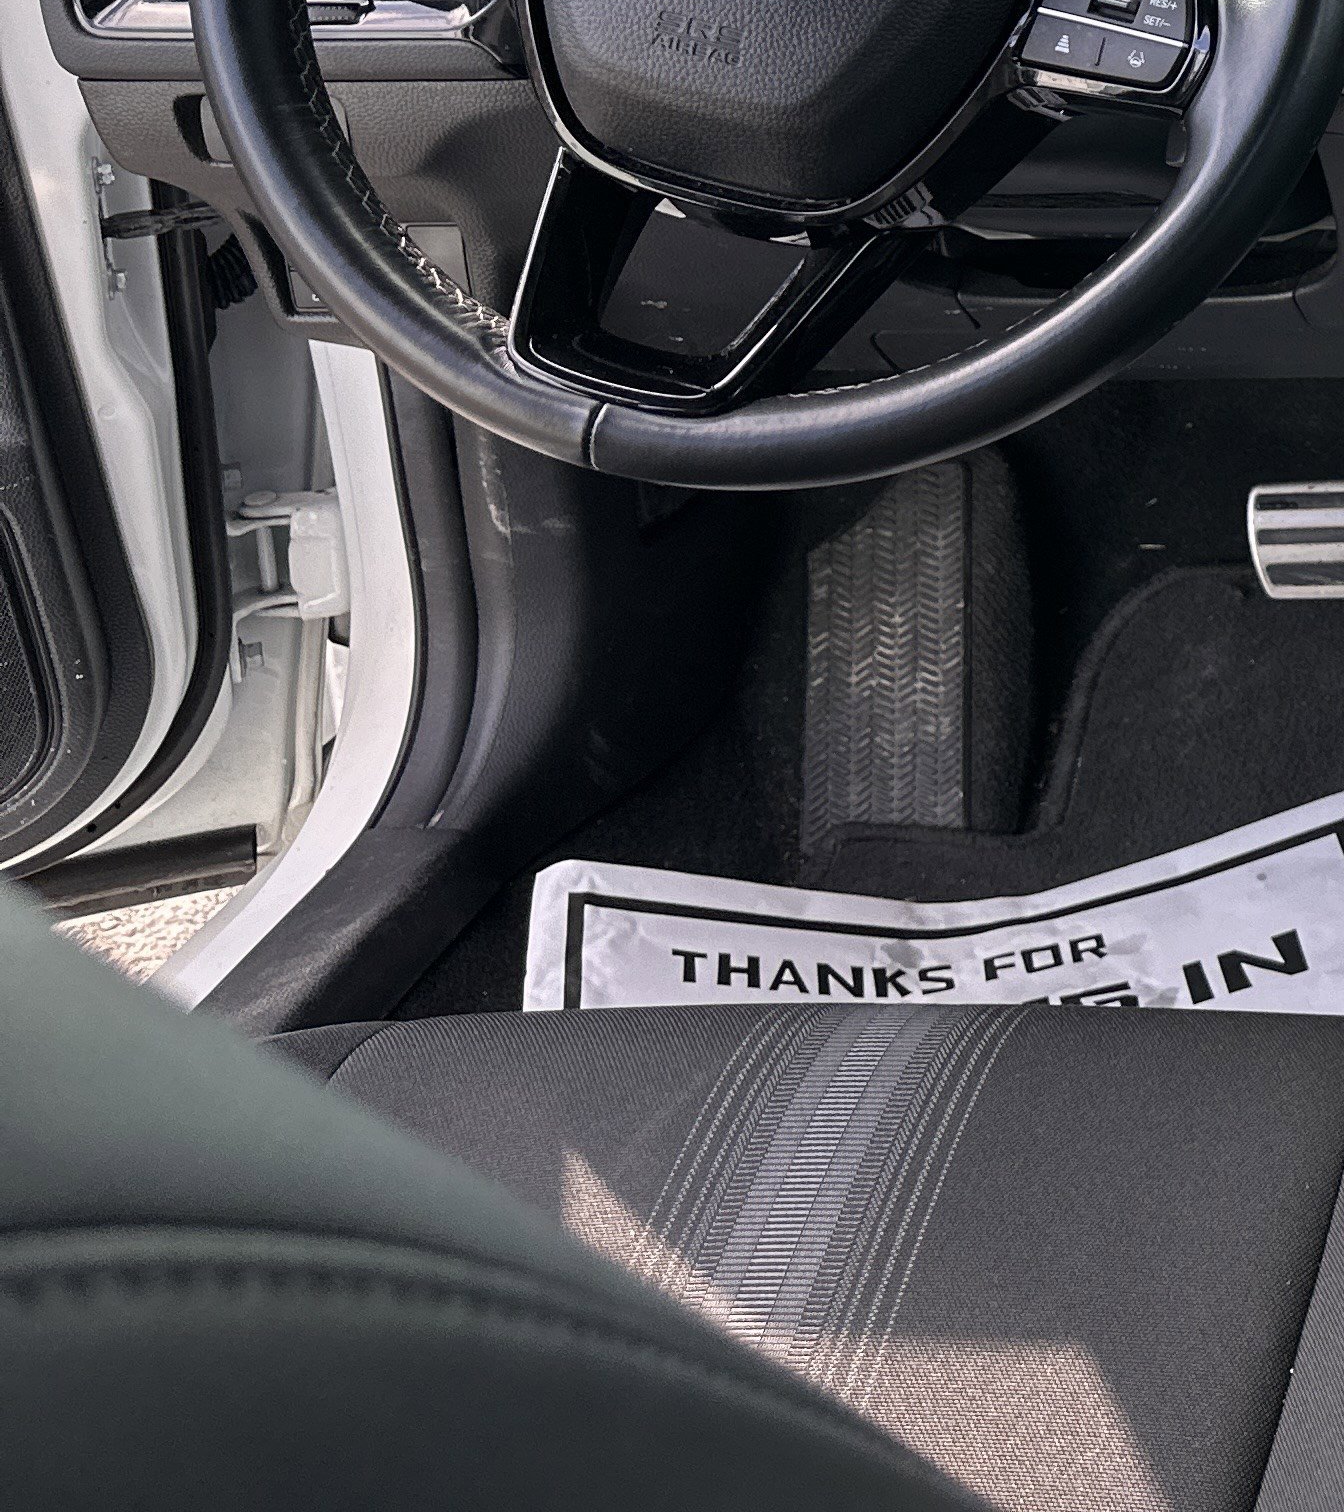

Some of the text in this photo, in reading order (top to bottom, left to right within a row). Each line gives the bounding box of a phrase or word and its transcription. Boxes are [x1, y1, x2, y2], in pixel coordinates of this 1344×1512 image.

[671, 932, 1109, 999] THANKS FOR
[1181, 928, 1309, 1005] IN
